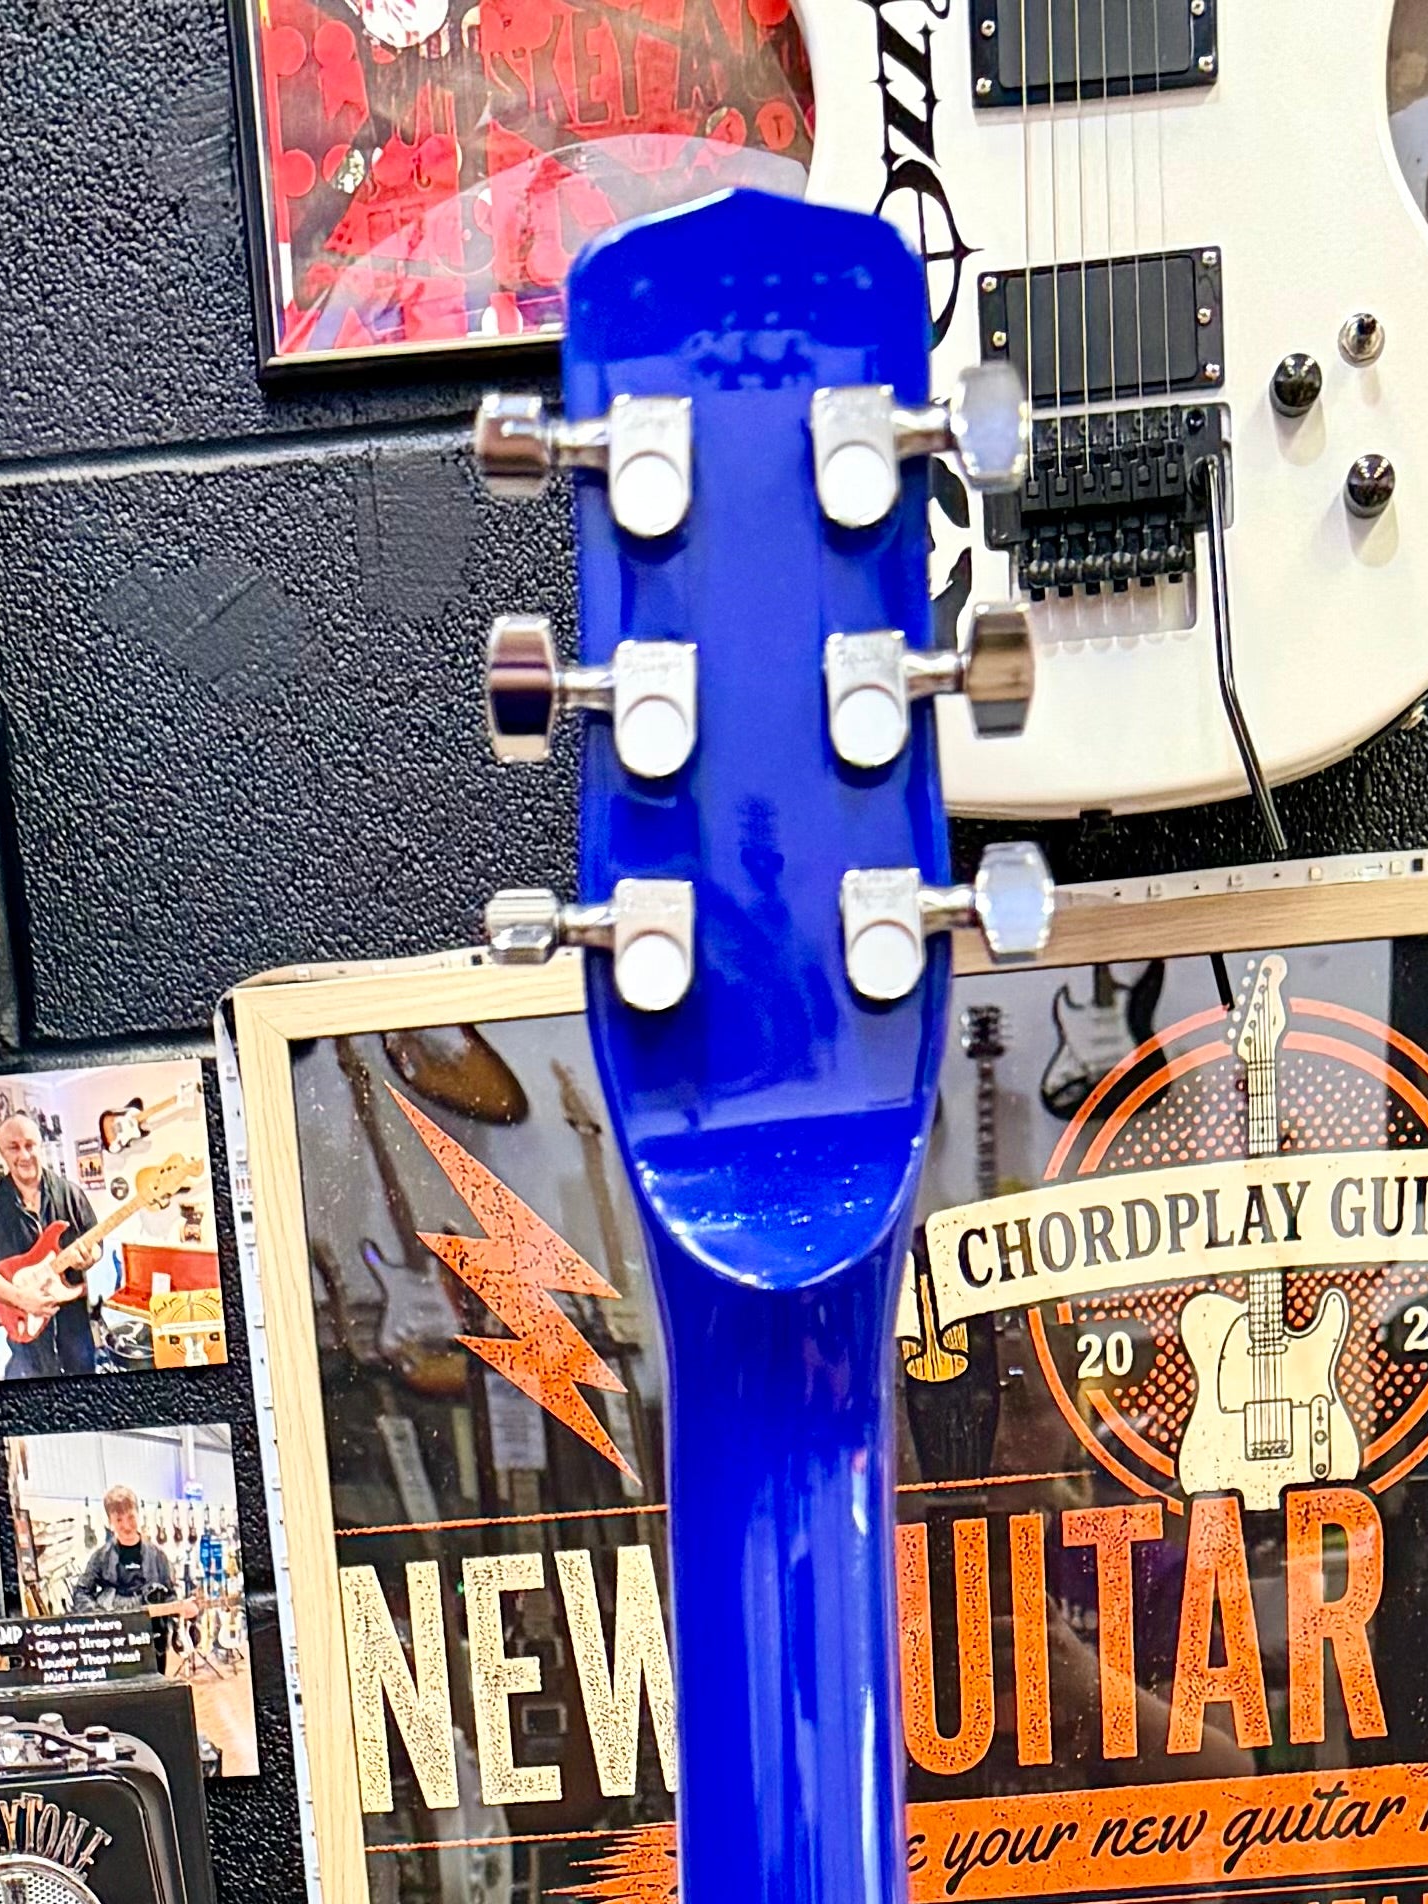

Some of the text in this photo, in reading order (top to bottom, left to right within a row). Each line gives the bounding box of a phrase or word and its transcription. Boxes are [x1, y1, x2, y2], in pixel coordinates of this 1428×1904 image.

[956, 1179, 1310, 1288] CHORDPLAY
[1077, 1331, 1134, 1380] 20
[64, 1619, 122, 1637] Anywhere
[83, 1653, 111, 1667] Than
[339, 1544, 677, 1813] NEW
[892, 1486, 1387, 1777] UITAR
[942, 1818, 1079, 1892] your
[1090, 1806, 1208, 1860] new
[1221, 1781, 1404, 1874] guitar
